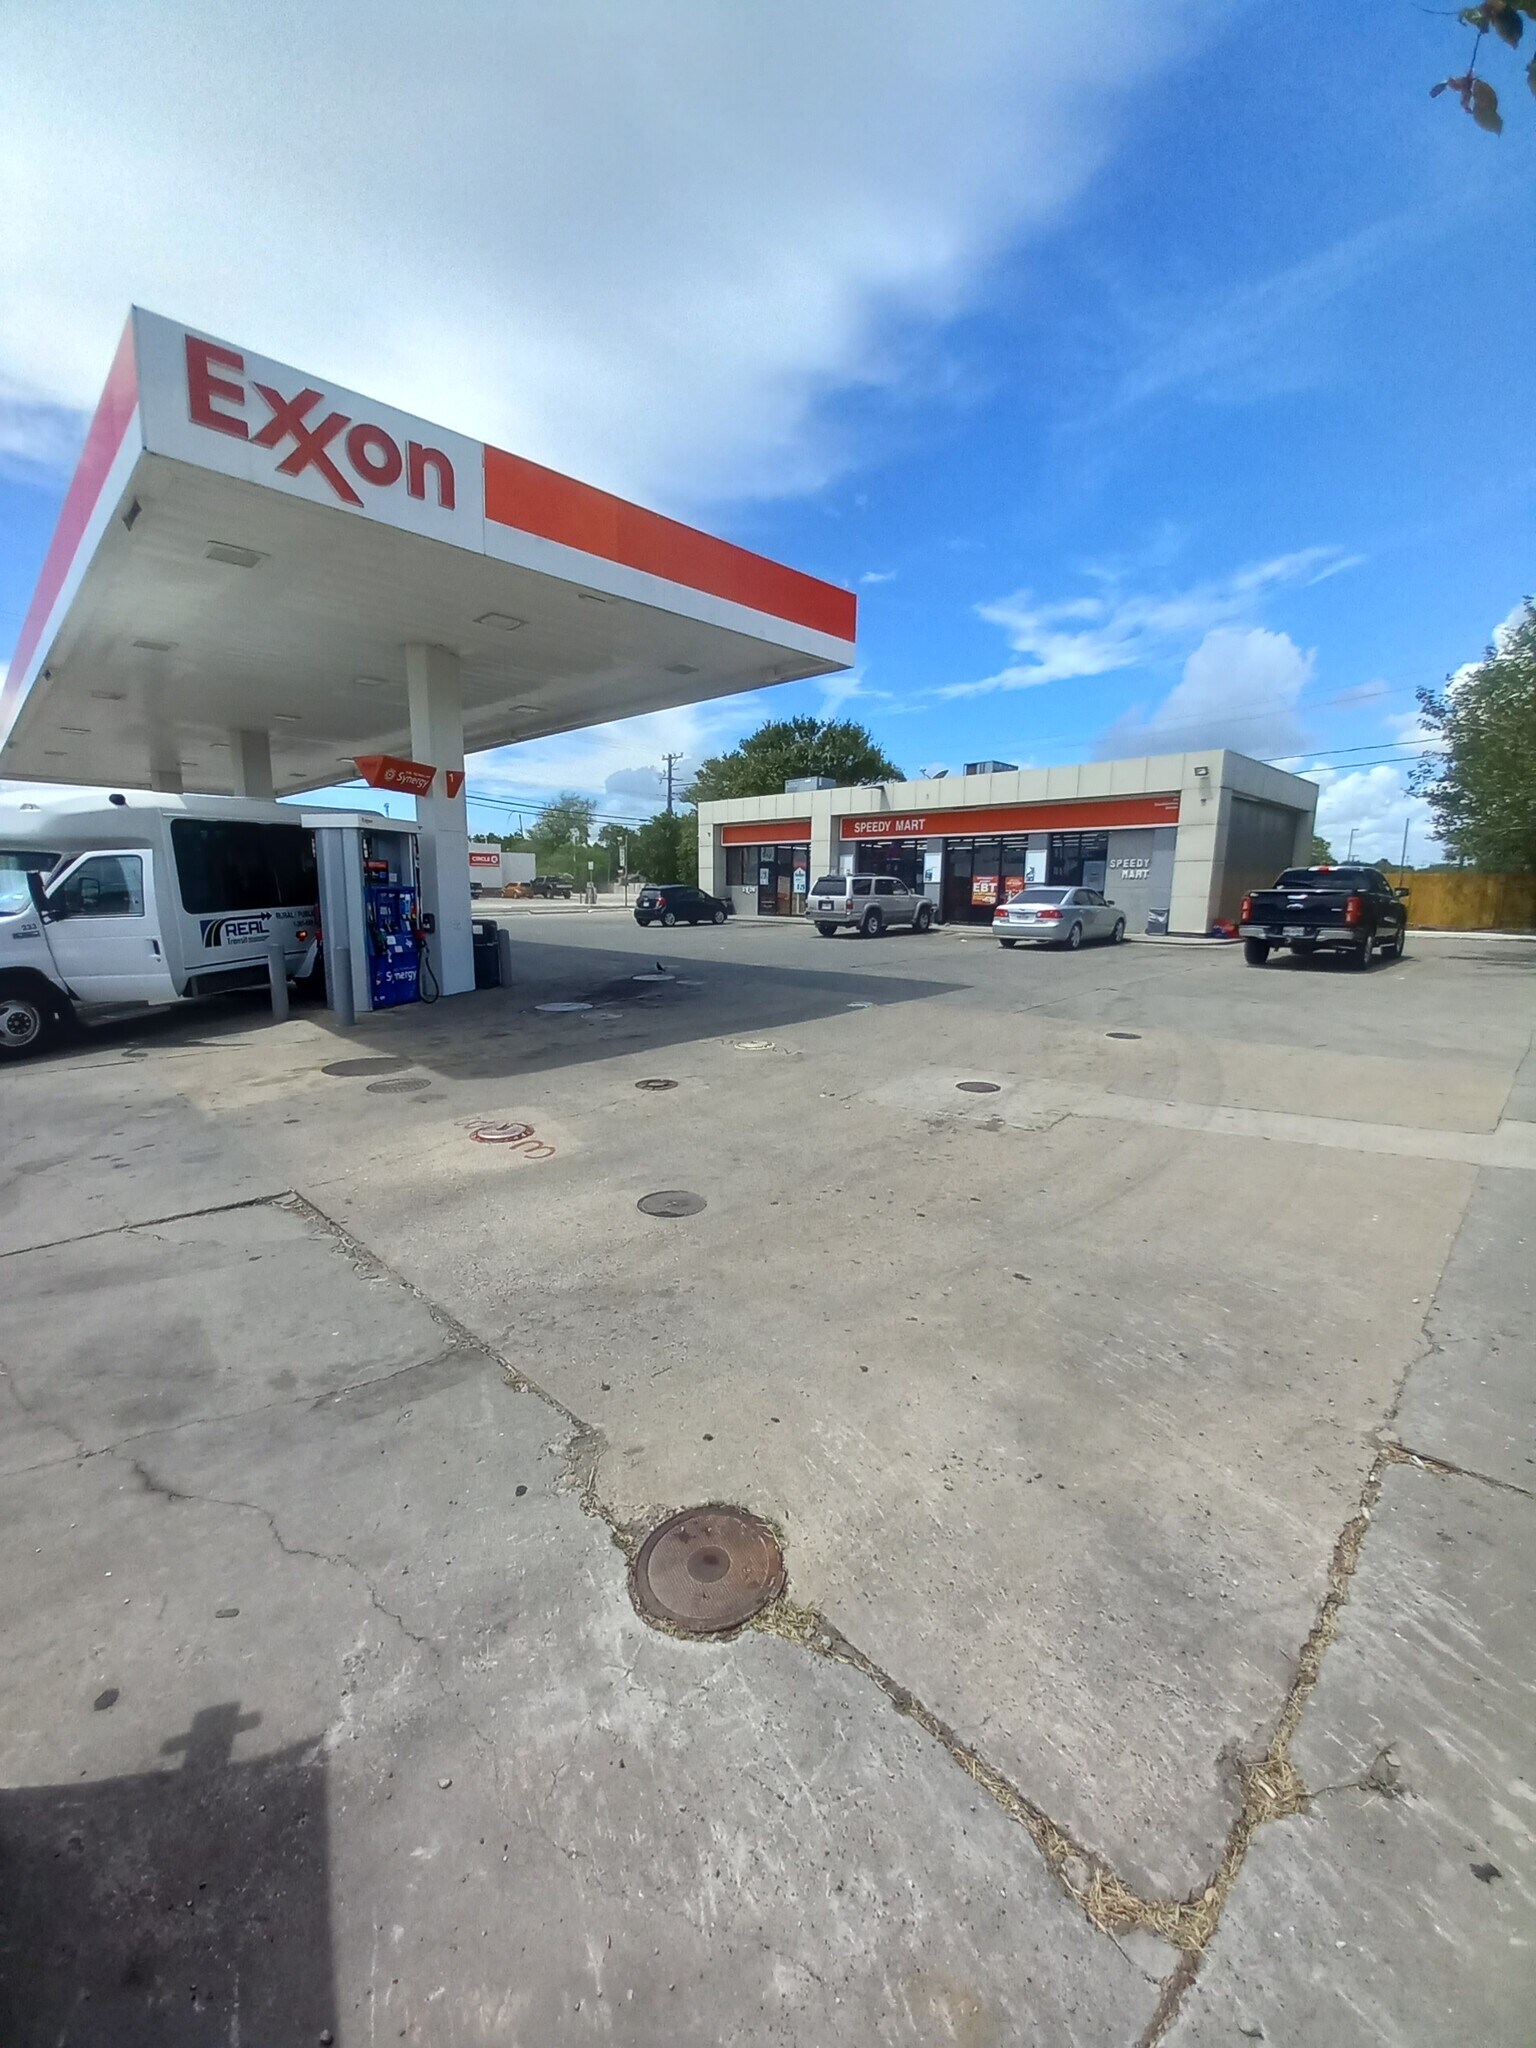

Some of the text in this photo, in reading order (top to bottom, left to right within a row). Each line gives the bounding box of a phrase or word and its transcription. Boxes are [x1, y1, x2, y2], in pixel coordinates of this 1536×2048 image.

[185, 334, 455, 510] Exxon
[397, 772, 429, 788] Synergy
[449, 773, 454, 783] 1
[854, 819, 926, 833] SPEEDY MART
[1110, 858, 1150, 869] SPEEDY
[1121, 869, 1150, 879] MART
[973, 882, 998, 893] EBT
[225, 921, 269, 937] REAL
